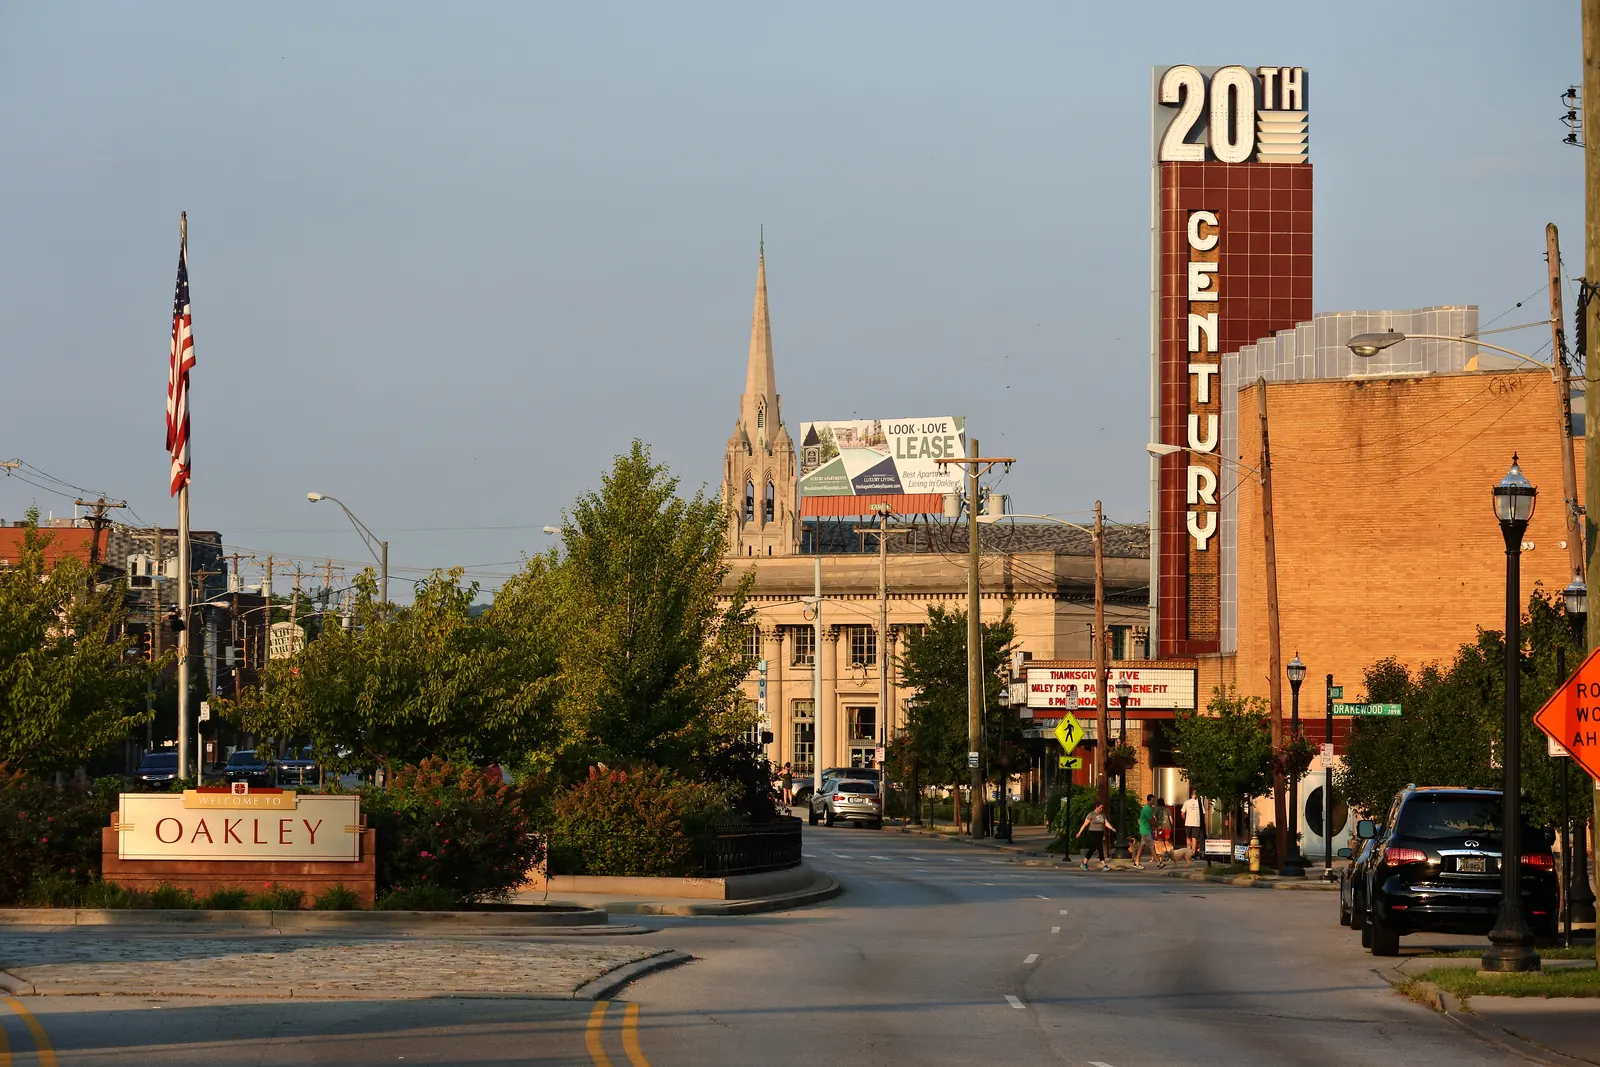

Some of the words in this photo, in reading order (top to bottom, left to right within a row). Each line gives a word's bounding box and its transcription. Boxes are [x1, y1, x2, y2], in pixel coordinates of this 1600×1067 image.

[1158, 64, 1303, 163] 20TH
[1187, 210, 1219, 550] CENTURY
[888, 424, 915, 435] LOOK
[922, 422, 948, 433] LOVE
[896, 435, 955, 459] LEASE
[902, 471, 915, 479] Best
[917, 470, 950, 479] Apartment
[908, 480, 927, 488] Living
[1050, 671, 1113, 680] THANKSGIVG
[1084, 684, 1117, 693] PAR
[1048, 697, 1054, 706] 8
[1078, 697, 1098, 706] NOA
[1110, 697, 1141, 706] SMTH
[1333, 704, 1383, 714] DRAKEWOOD
[199, 796, 259, 806] WELCOME
[265, 797, 281, 806] TO
[155, 817, 323, 844] OAKLEY
